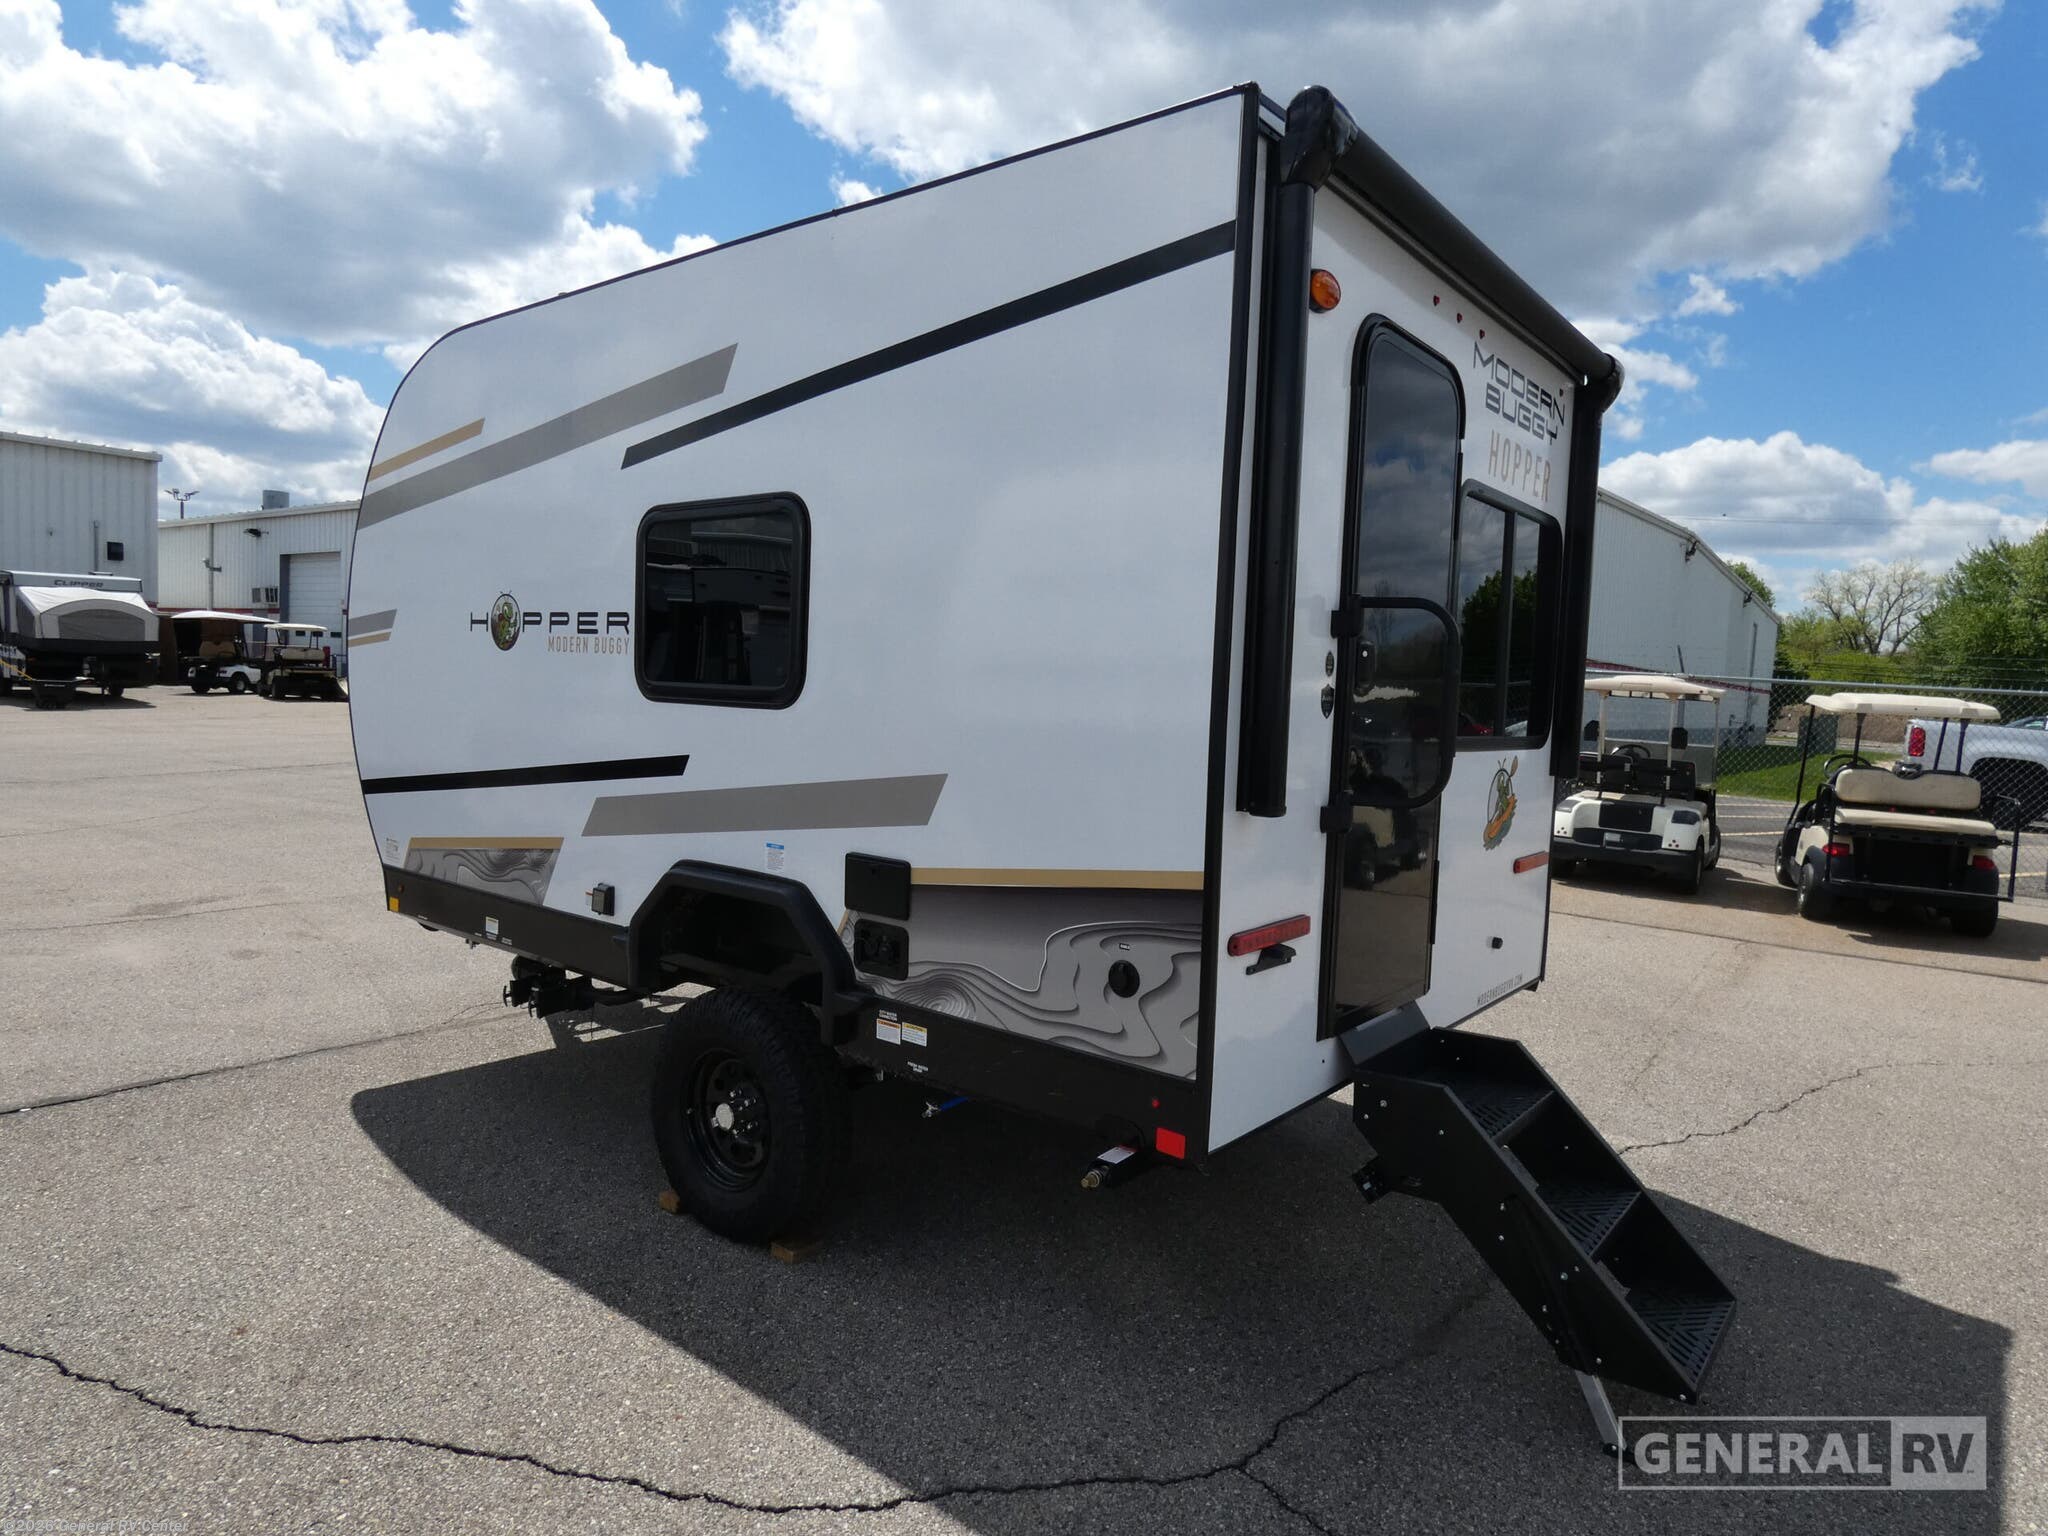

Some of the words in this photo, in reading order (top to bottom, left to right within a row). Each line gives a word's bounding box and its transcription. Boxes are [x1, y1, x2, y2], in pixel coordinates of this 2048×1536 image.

[1473, 341, 1566, 426] MODERN
[1486, 382, 1558, 446] BUGGY
[1488, 429, 1551, 502] HOPPER
[54, 579, 104, 588] CLIPPER
[548, 635, 589, 654] MODERN
[594, 636, 630, 655] BUGGY
